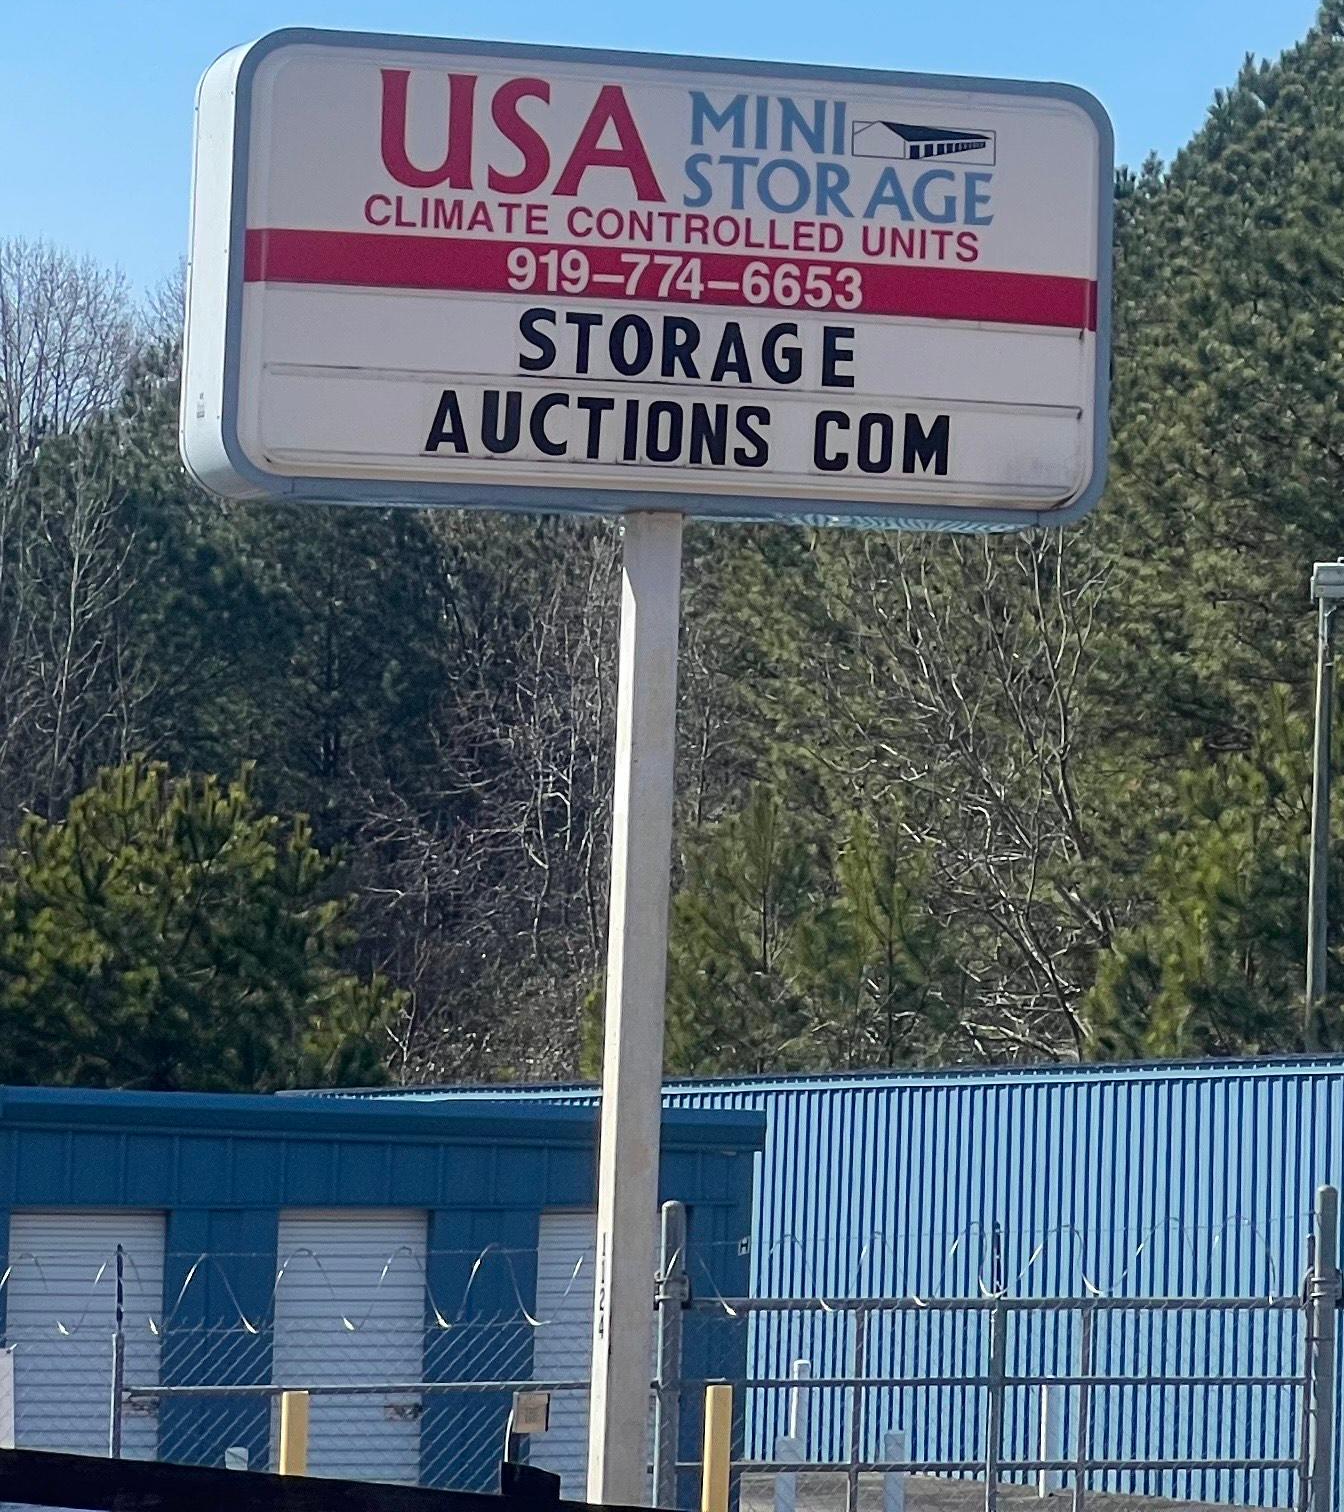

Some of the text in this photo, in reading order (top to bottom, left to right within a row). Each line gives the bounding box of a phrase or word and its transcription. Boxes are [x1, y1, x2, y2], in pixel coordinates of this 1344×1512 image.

[380, 68, 667, 203] USA
[689, 90, 847, 155] MINI
[683, 153, 995, 225] STORAGE
[364, 194, 979, 263] CLIMATE CONTROLLED UNITS
[507, 247, 863, 310] 919-774-6653
[518, 307, 856, 388] STORAGE
[424, 389, 951, 476] AUCTIONS COM
